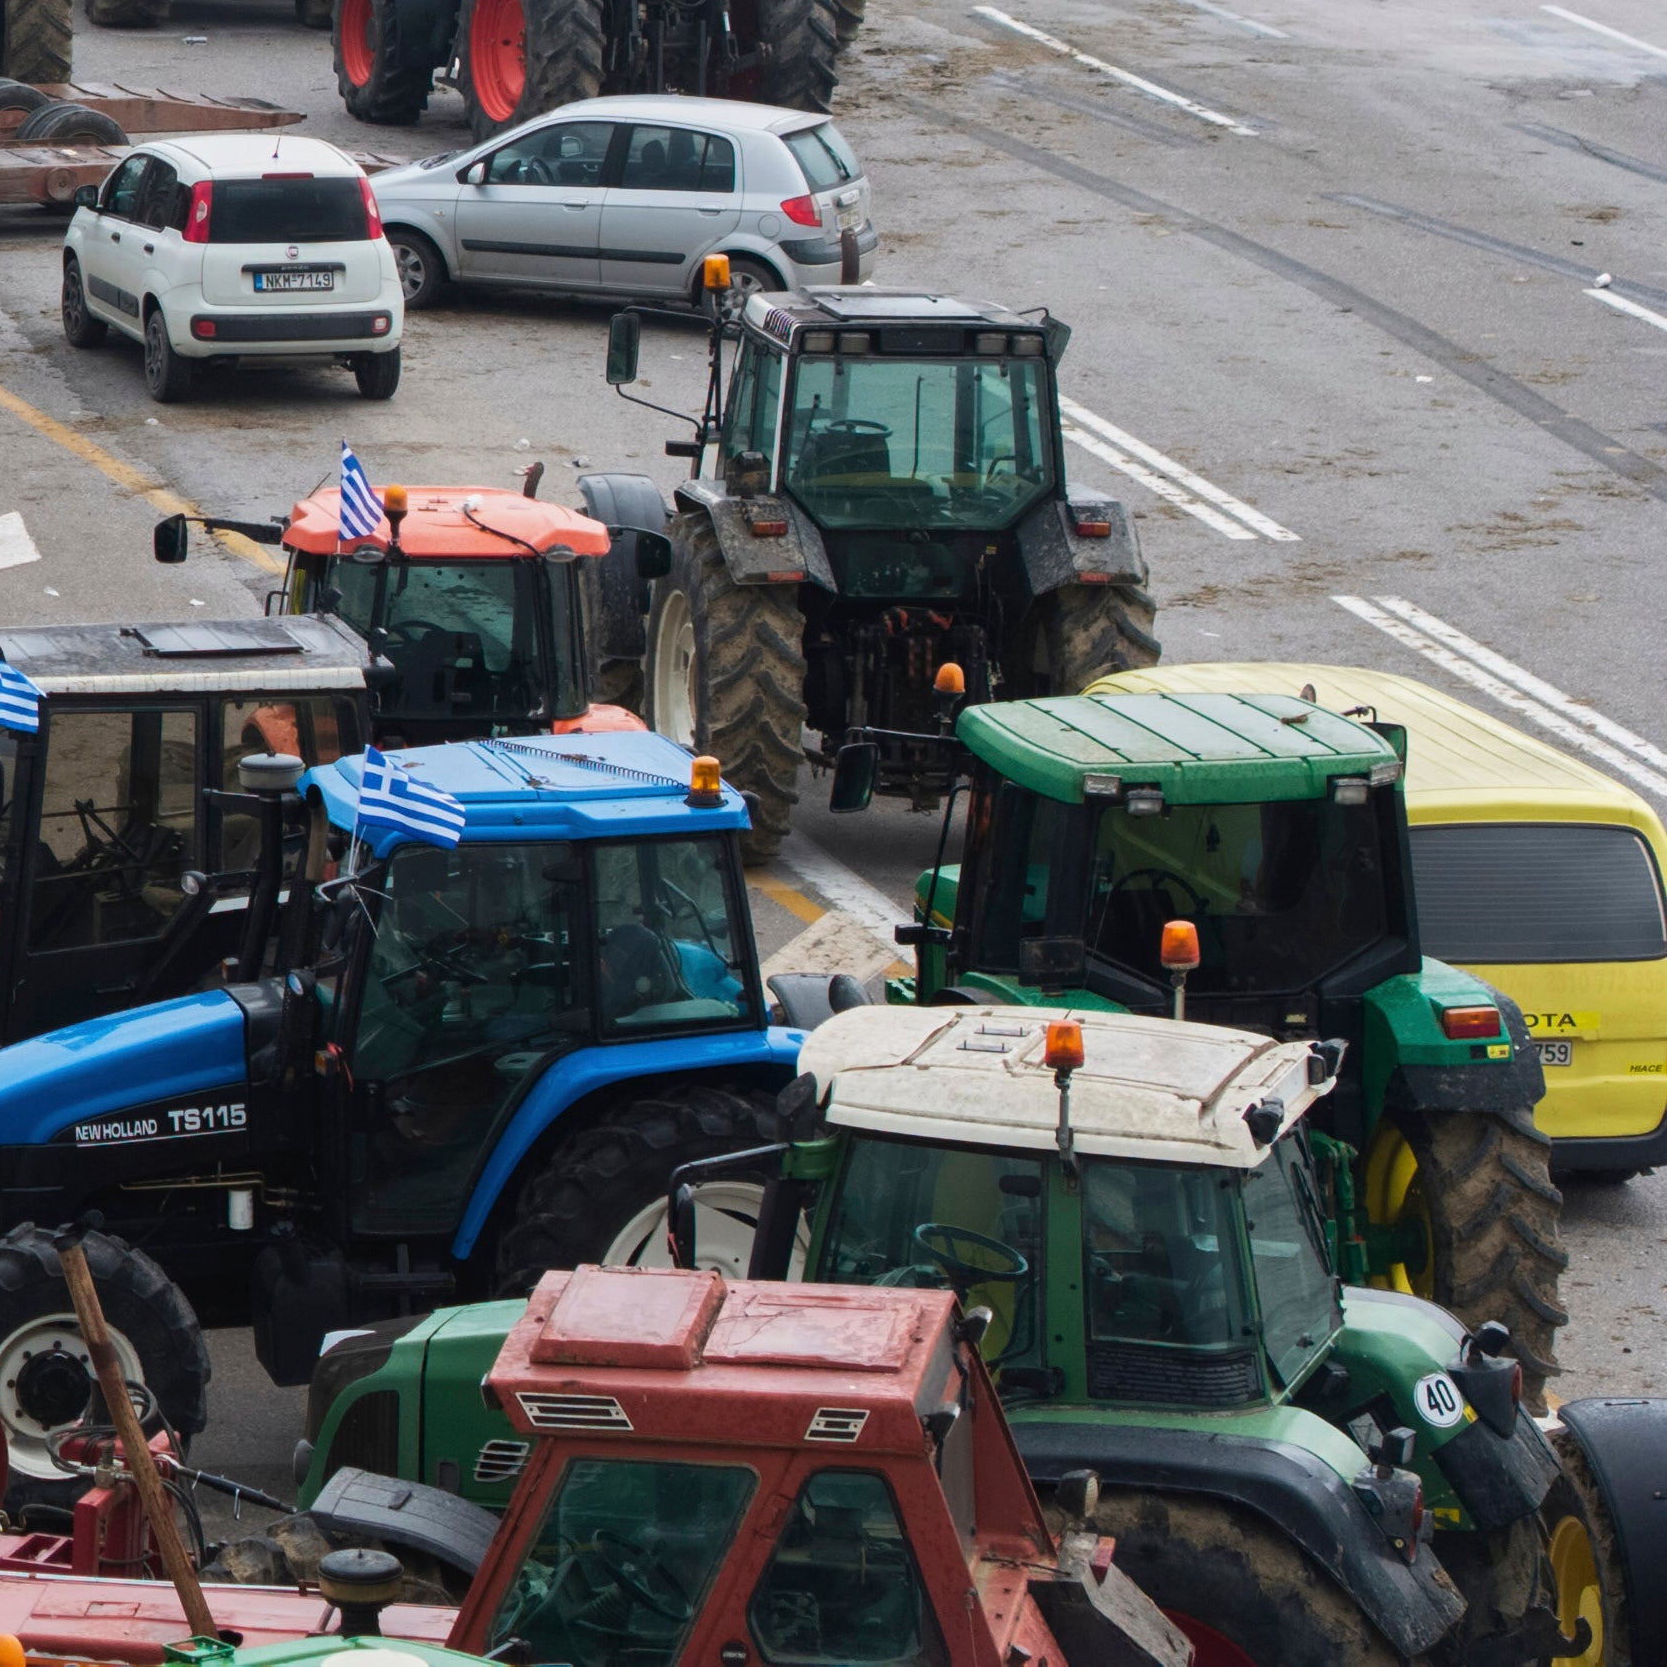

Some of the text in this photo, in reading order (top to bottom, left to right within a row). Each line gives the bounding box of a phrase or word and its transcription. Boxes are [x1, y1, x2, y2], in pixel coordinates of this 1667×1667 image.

[1522, 1013, 1577, 1028] OTA
[1534, 1043, 1569, 1063] 759
[1629, 1064, 1663, 1074] HIACE
[102, 1119, 158, 1138] HOLLAND
[168, 1104, 247, 1132] TS115
[1426, 1379, 1457, 1417] 40
